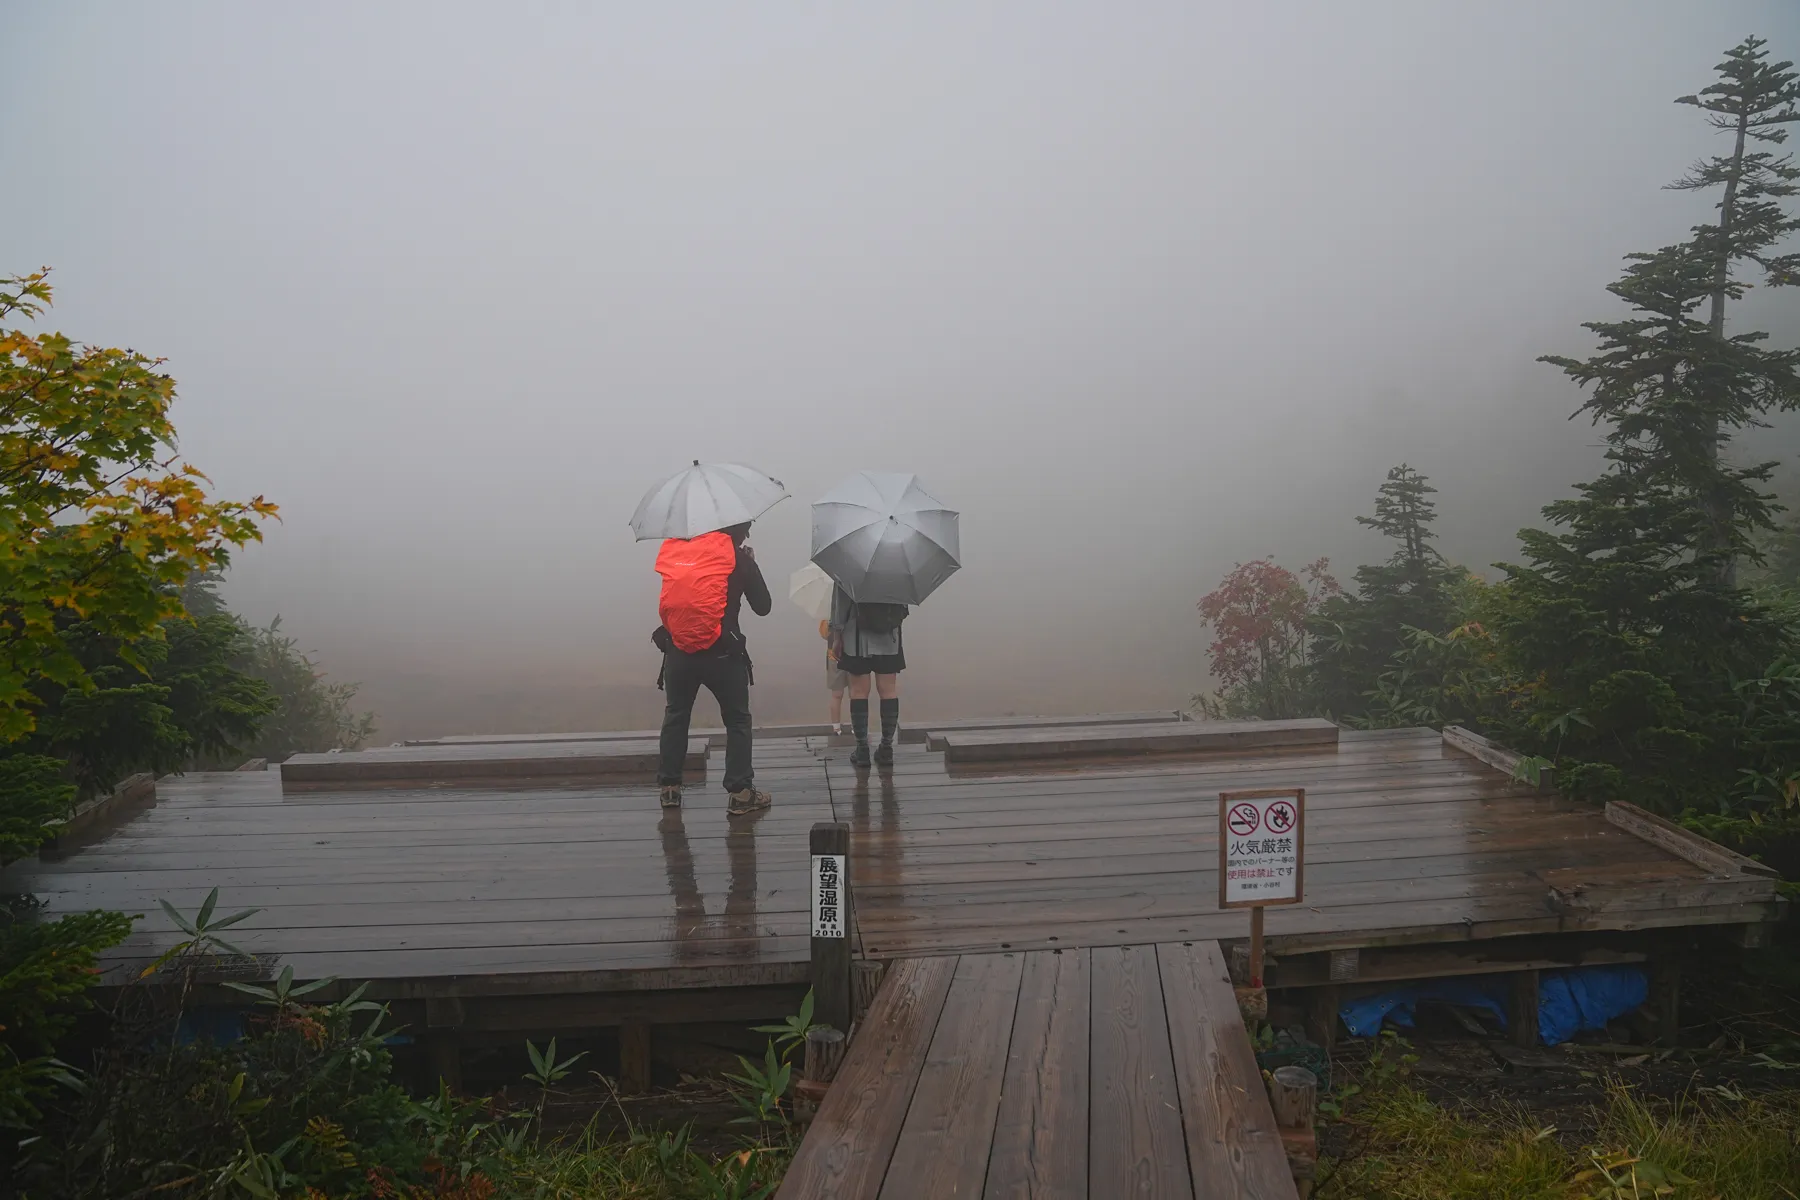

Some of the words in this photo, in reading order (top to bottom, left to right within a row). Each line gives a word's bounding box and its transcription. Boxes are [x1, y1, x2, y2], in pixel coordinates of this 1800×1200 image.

[1230, 838, 1292, 856] 火気厳禁
[1228, 867, 1294, 879] 使用は禁止です
[819, 857, 838, 923] 展望湿原
